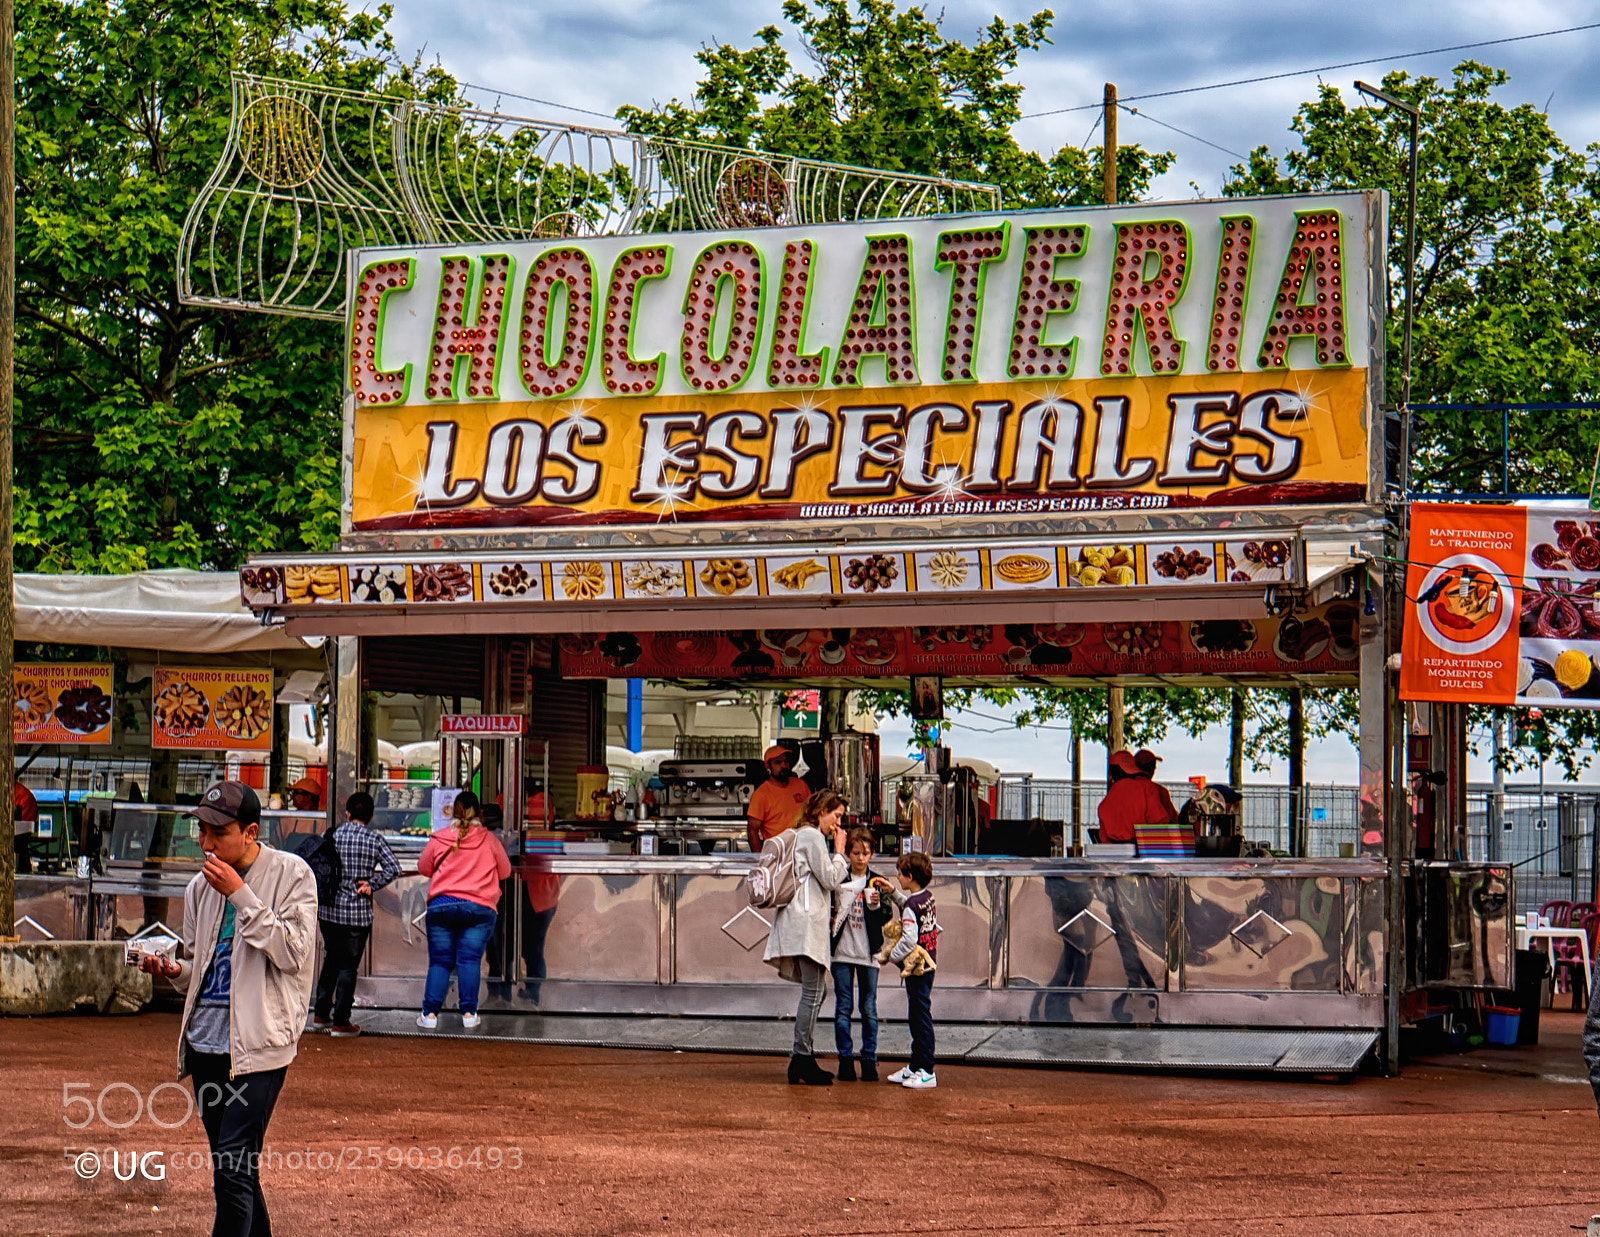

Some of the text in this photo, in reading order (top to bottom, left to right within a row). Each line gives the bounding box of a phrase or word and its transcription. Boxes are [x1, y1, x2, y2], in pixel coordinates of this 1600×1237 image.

[349, 208, 1353, 407] CHOCOLATERIA
[416, 390, 1307, 507] LOS ESPECIALES
[800, 495, 1168, 517] WWW.CHOCOLATERIALOSESPECIALES.COM
[1429, 528, 1514, 540] MANTENIENDO
[1430, 539, 1512, 550] LA TRADICIÓN
[1182, 650, 1269, 661] CHURROS RELLENOS
[1423, 658, 1503, 669] REPARTIENDO
[23, 665, 110, 677] CHURRITOS Y BAÑADOS
[181, 671, 222, 682] CHURROS
[224, 672, 270, 683] RELLENOS
[1428, 669, 1493, 679] MOMENTOS
[38, 679, 93, 689] DE CHOCOLATE
[1440, 679, 1484, 689] DULCES
[447, 716, 520, 731] TAQUILLA
